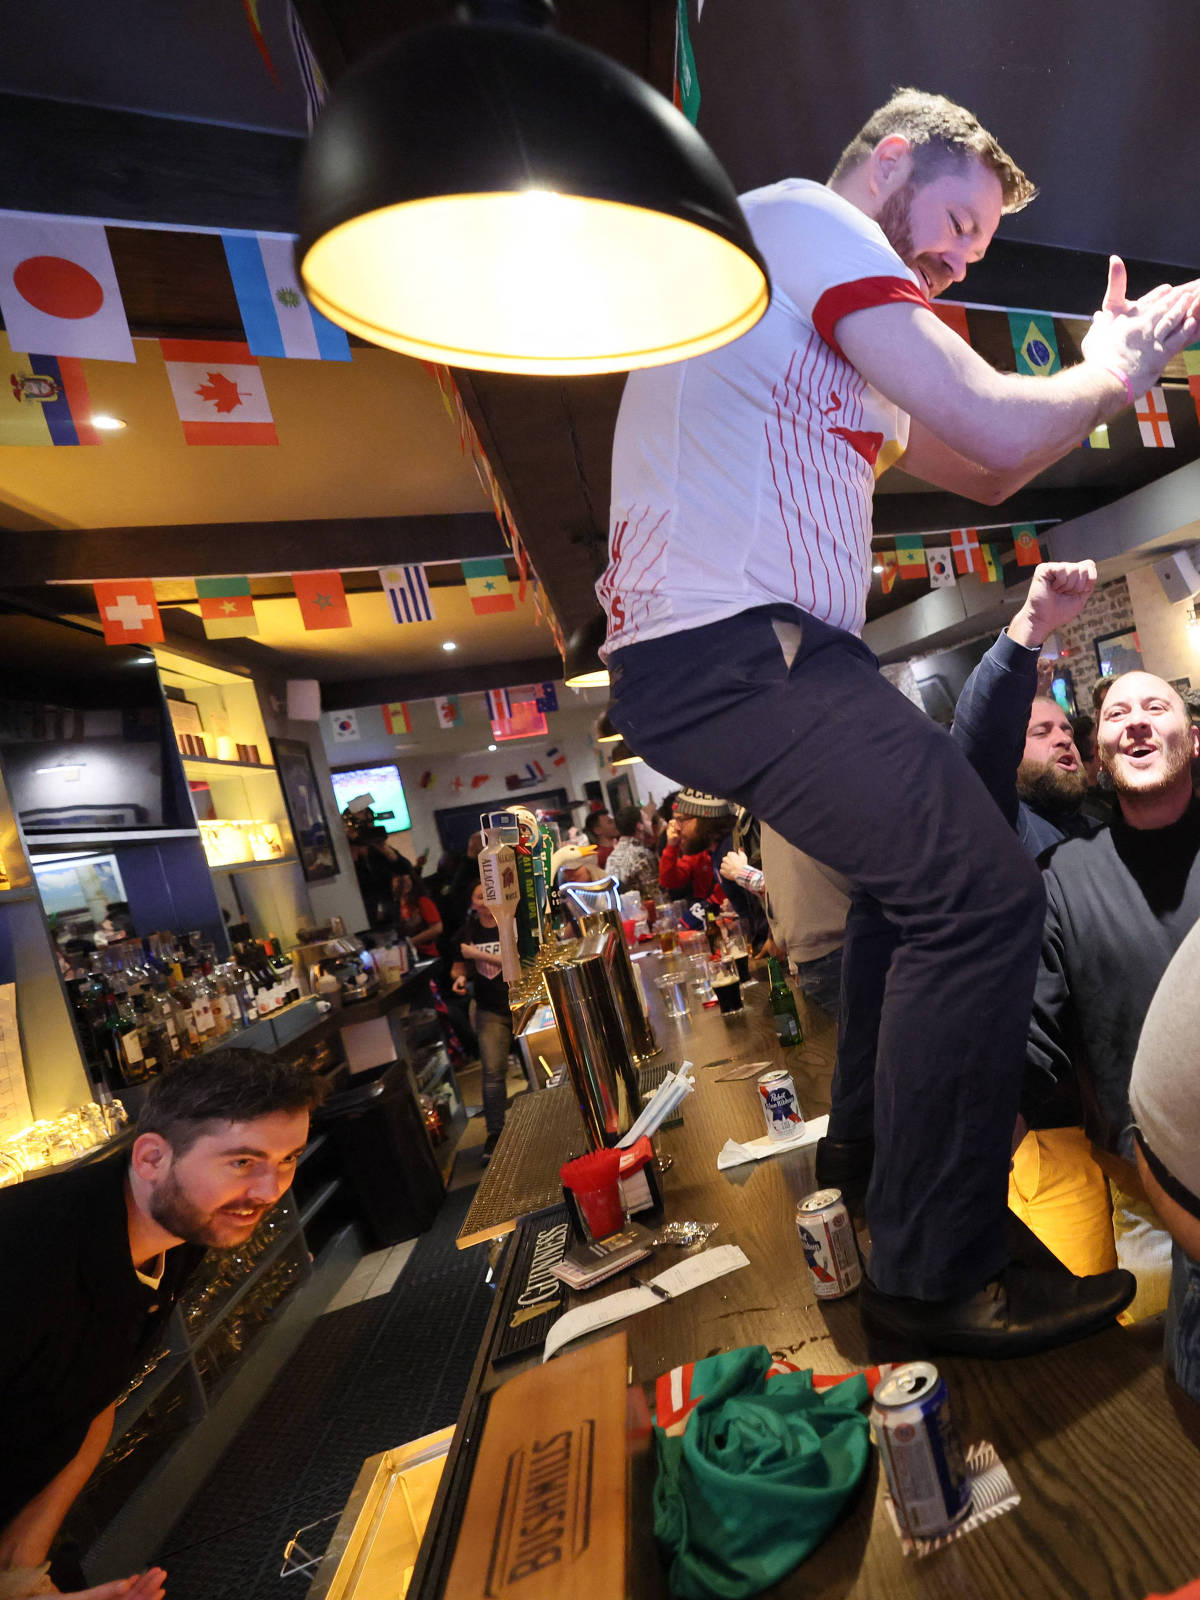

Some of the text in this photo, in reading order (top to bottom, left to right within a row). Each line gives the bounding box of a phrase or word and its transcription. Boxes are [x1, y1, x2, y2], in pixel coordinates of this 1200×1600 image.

[482, 858, 496, 901] ALLAGASH
[526, 879, 535, 898] DAY
[528, 902, 536, 919] IPA
[517, 1223, 568, 1305] GUINNESS
[507, 1431, 573, 1584] BUSHMILLS
